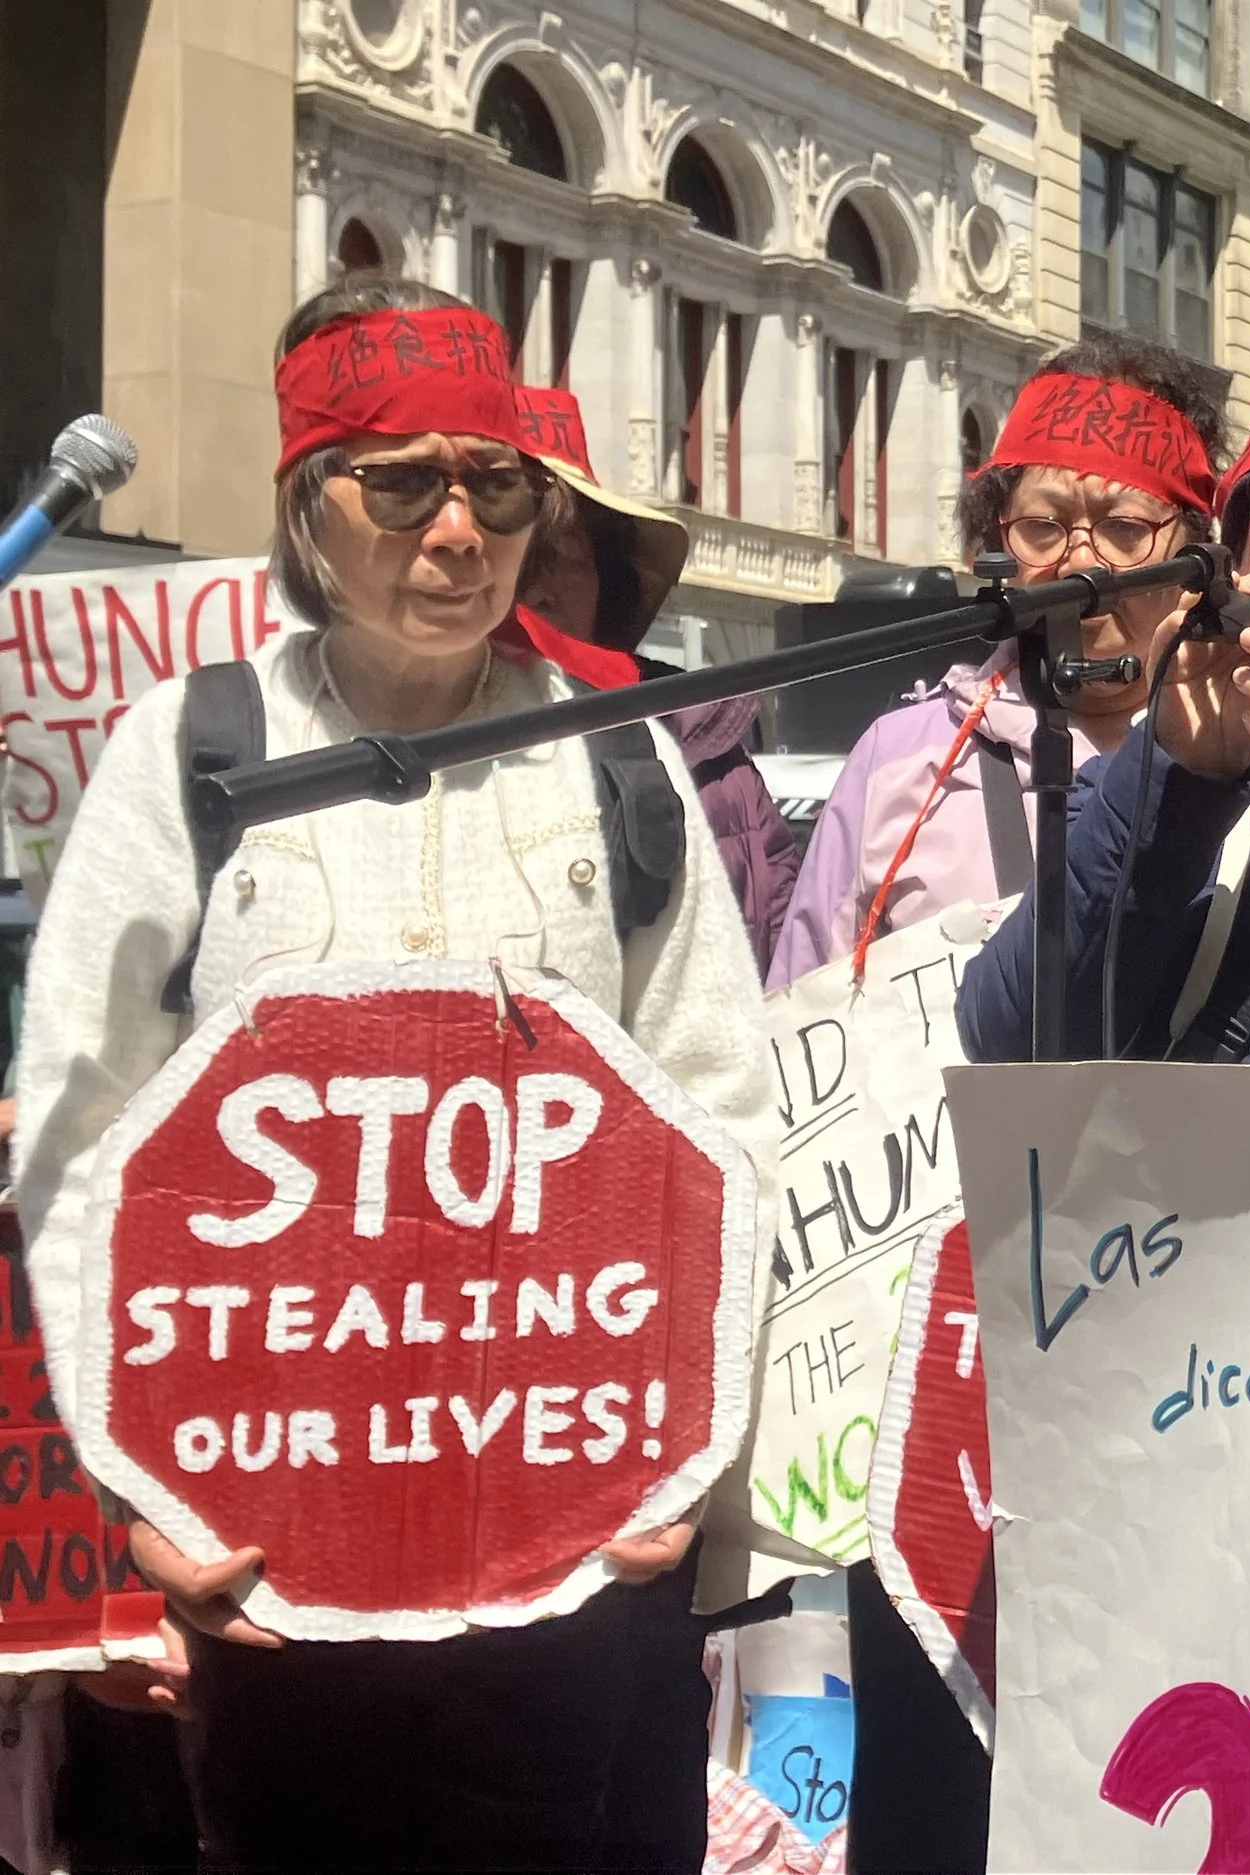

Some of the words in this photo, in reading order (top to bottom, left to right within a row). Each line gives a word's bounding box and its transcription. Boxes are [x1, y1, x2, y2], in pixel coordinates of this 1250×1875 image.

[187, 1073, 604, 1249] STOP
[1027, 1147, 1184, 1353] Las
[123, 1261, 658, 1366] STEALING
[772, 1320, 866, 1416] THE
[173, 1408, 339, 1473] OUR
[367, 1378, 667, 1466] LIVES!
